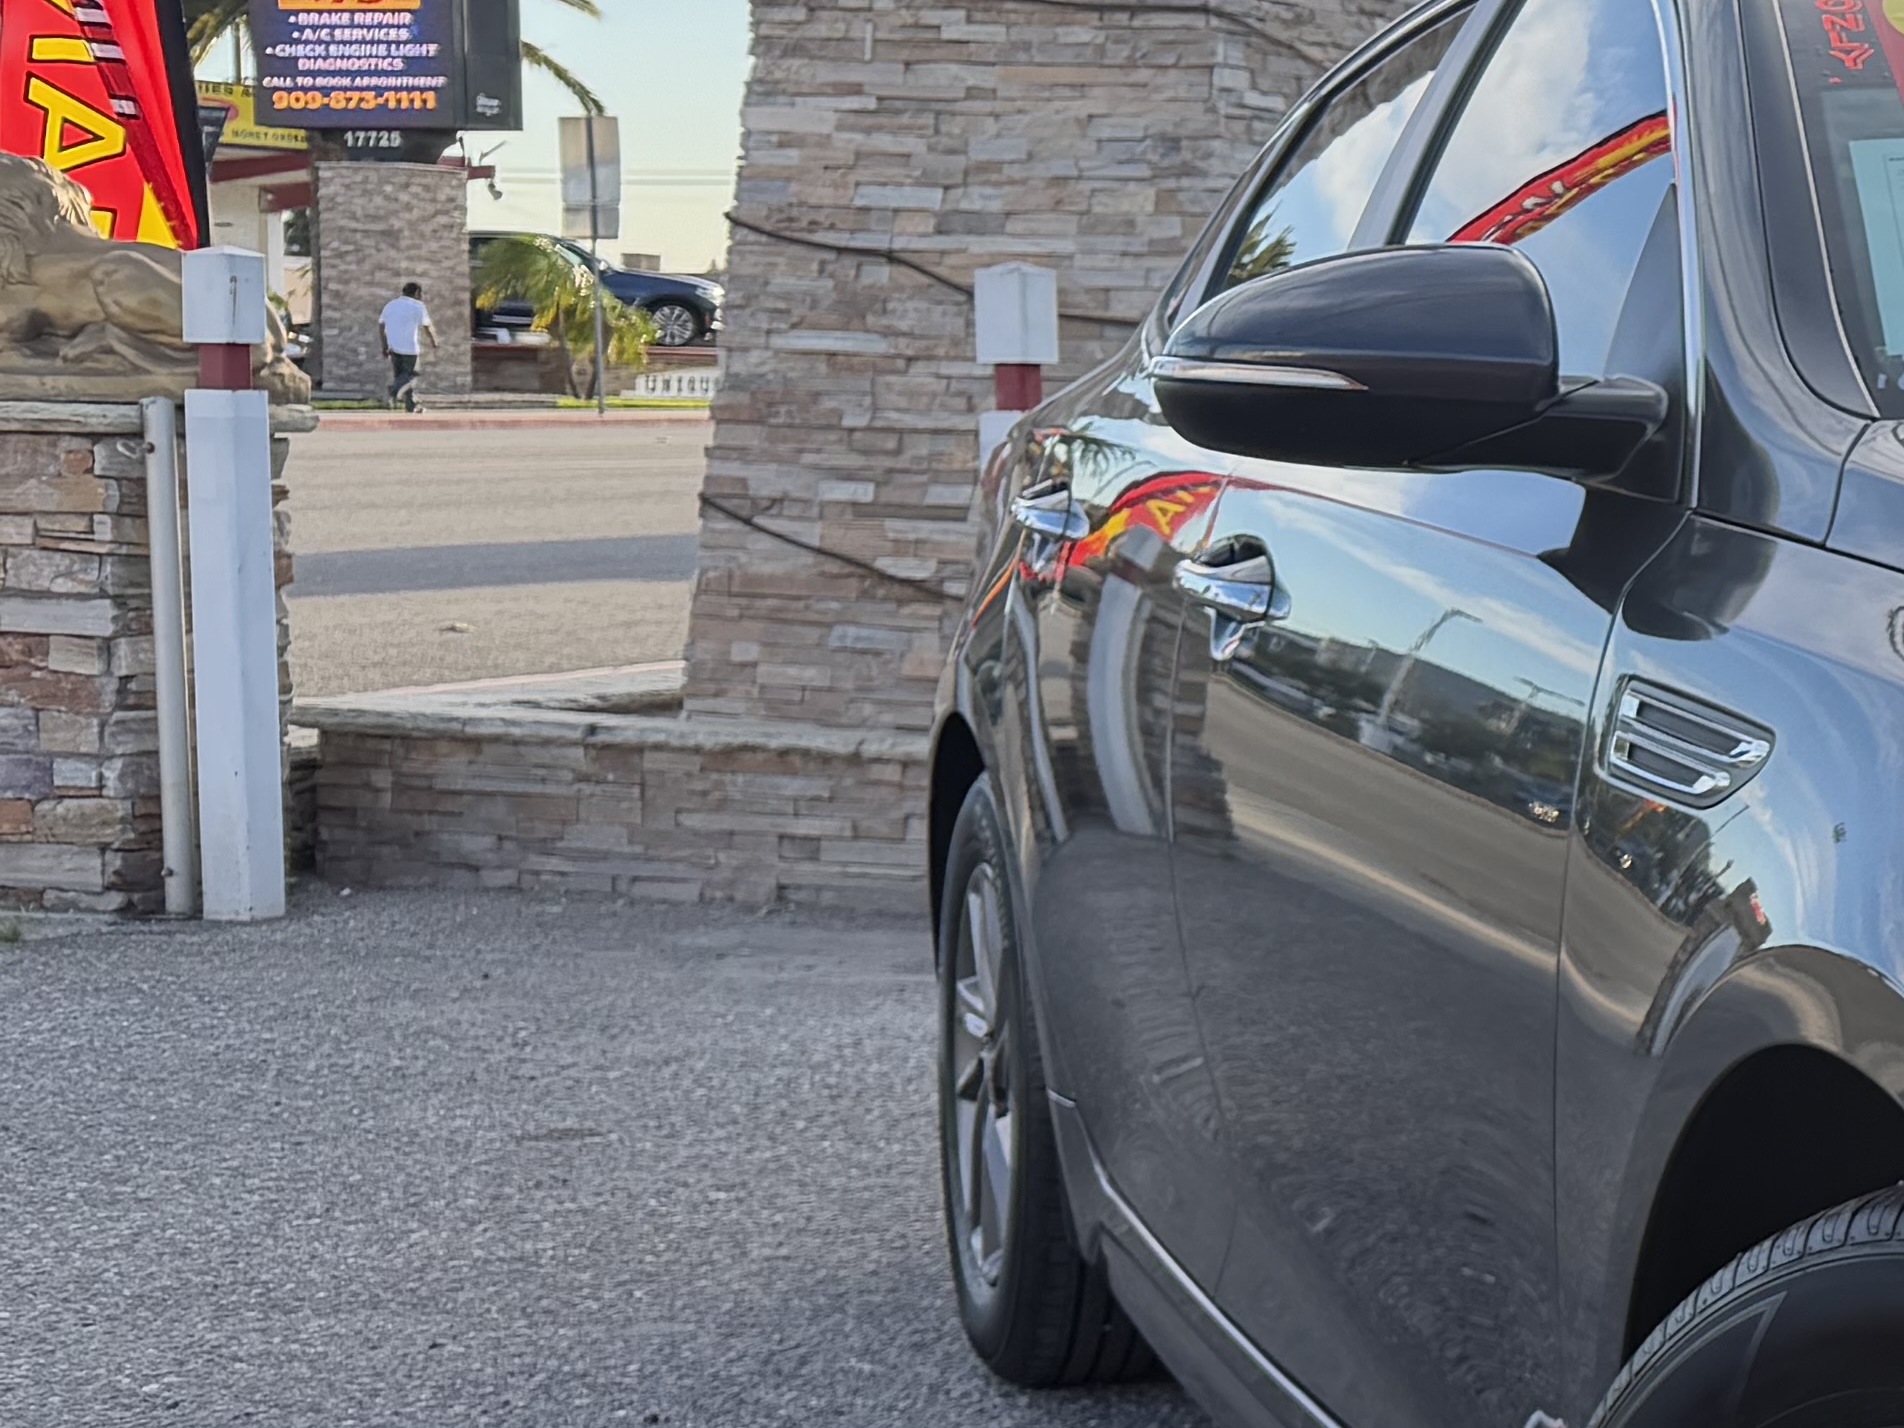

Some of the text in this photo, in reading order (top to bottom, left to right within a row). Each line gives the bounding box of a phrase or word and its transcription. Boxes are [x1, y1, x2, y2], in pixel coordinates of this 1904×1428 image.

[298, 12, 413, 26] BRAKE REPAIR
[301, 27, 411, 41] A/C SERVICES
[275, 43, 439, 57] CHECK ENGINE LIGHT
[297, 58, 405, 71] DIAGNOSTICS
[262, 76, 294, 88] CALL
[295, 76, 313, 87] TO
[272, 90, 438, 110] 909-873-1111
[343, 130, 402, 148] 17725
